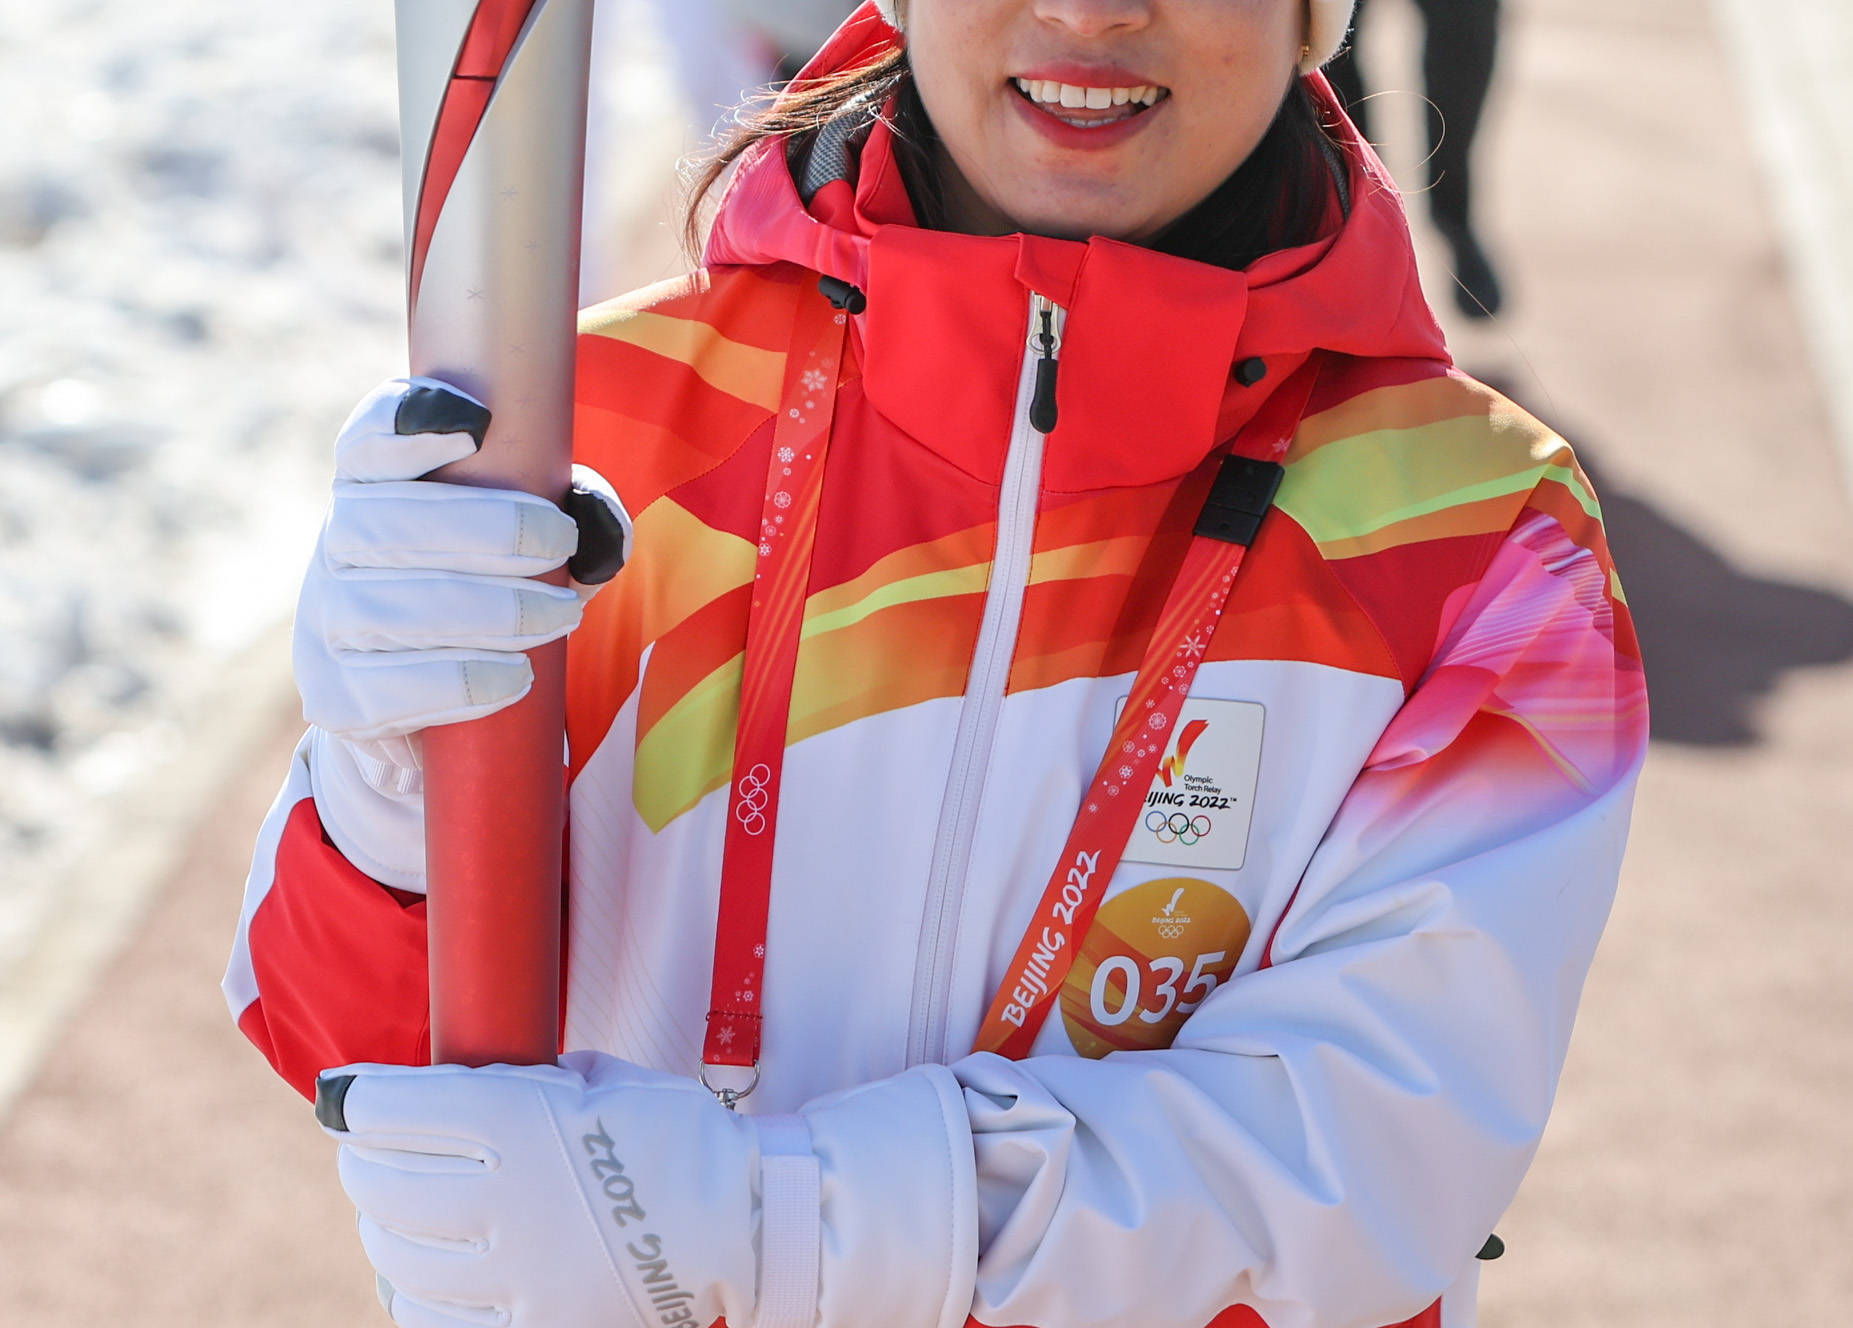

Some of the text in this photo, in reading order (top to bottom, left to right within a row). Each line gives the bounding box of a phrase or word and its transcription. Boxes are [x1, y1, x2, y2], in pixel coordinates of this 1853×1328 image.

[1144, 792, 1185, 807] IJING
[1184, 774, 1213, 784] Olympic
[1203, 786, 1221, 794] Relay
[1001, 849, 1102, 1027] BEIJING 2022
[1089, 951, 1226, 1026] 035
[582, 1115, 646, 1228] 2022
